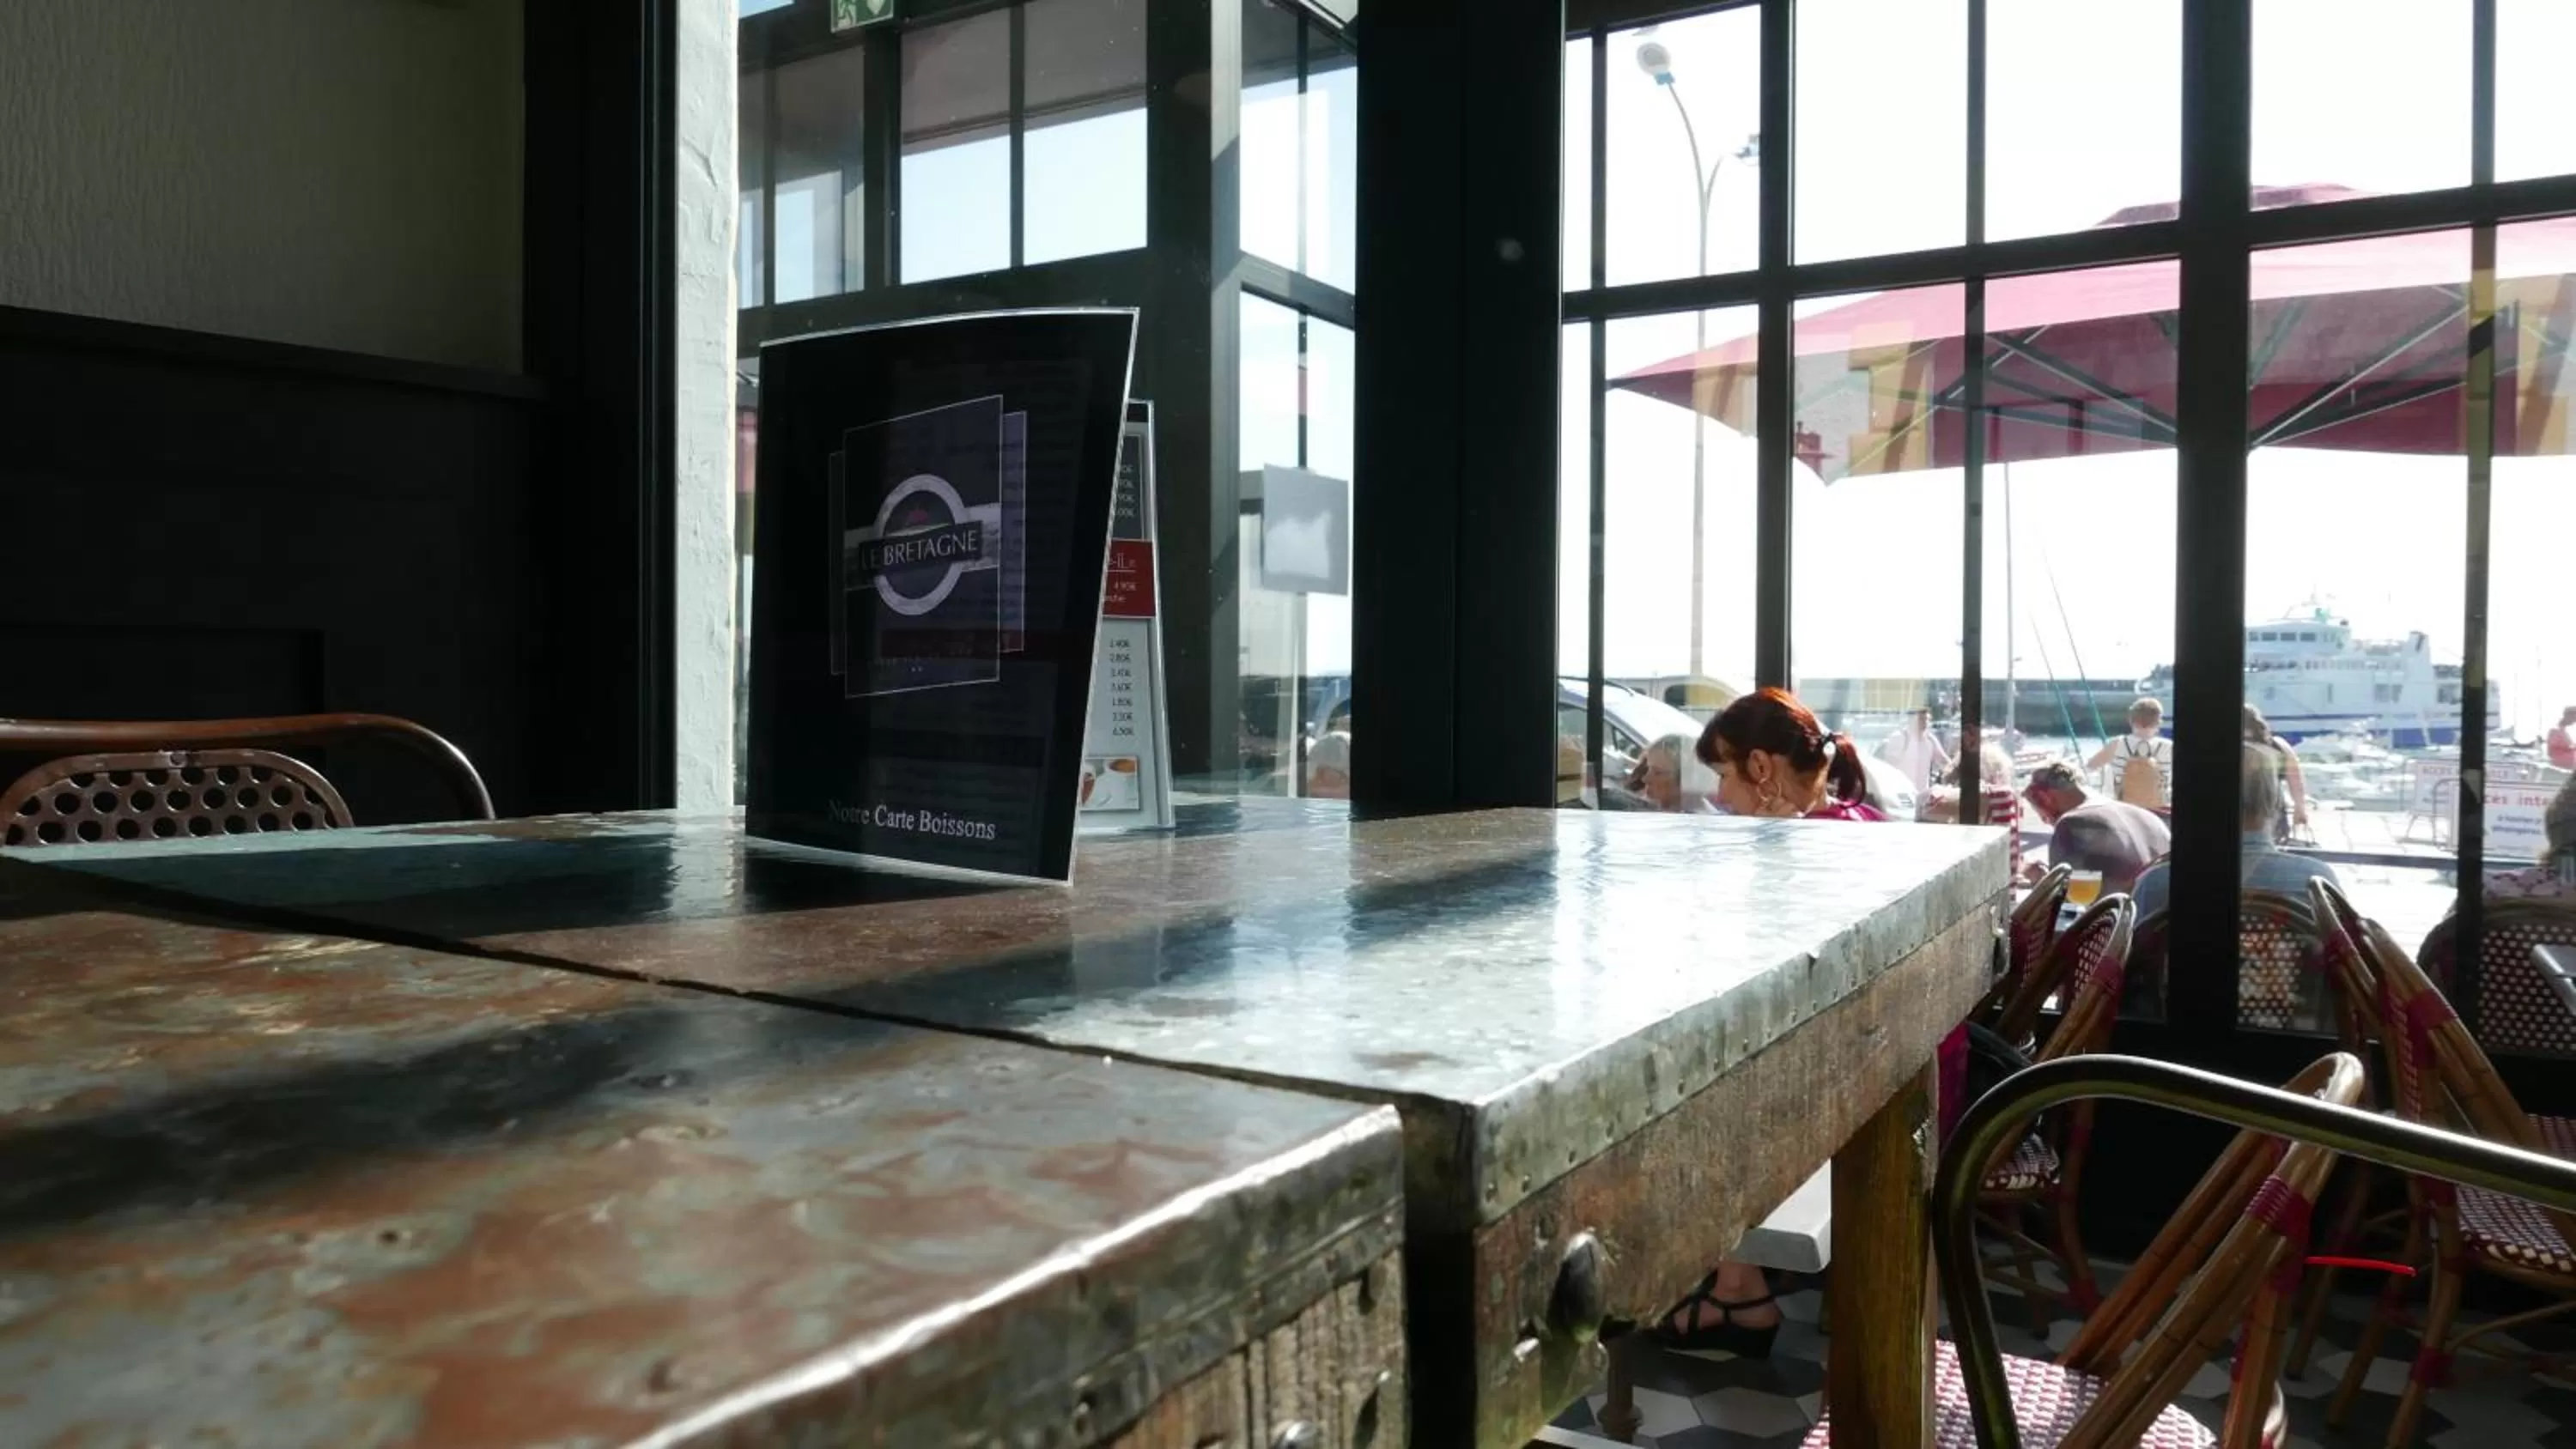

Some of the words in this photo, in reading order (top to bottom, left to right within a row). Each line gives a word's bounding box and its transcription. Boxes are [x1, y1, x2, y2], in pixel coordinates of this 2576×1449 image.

[883, 529, 977, 566] BRETAGNE
[829, 799, 870, 824] Notre
[874, 803, 914, 831] Carte
[919, 809, 996, 840] Boissons
